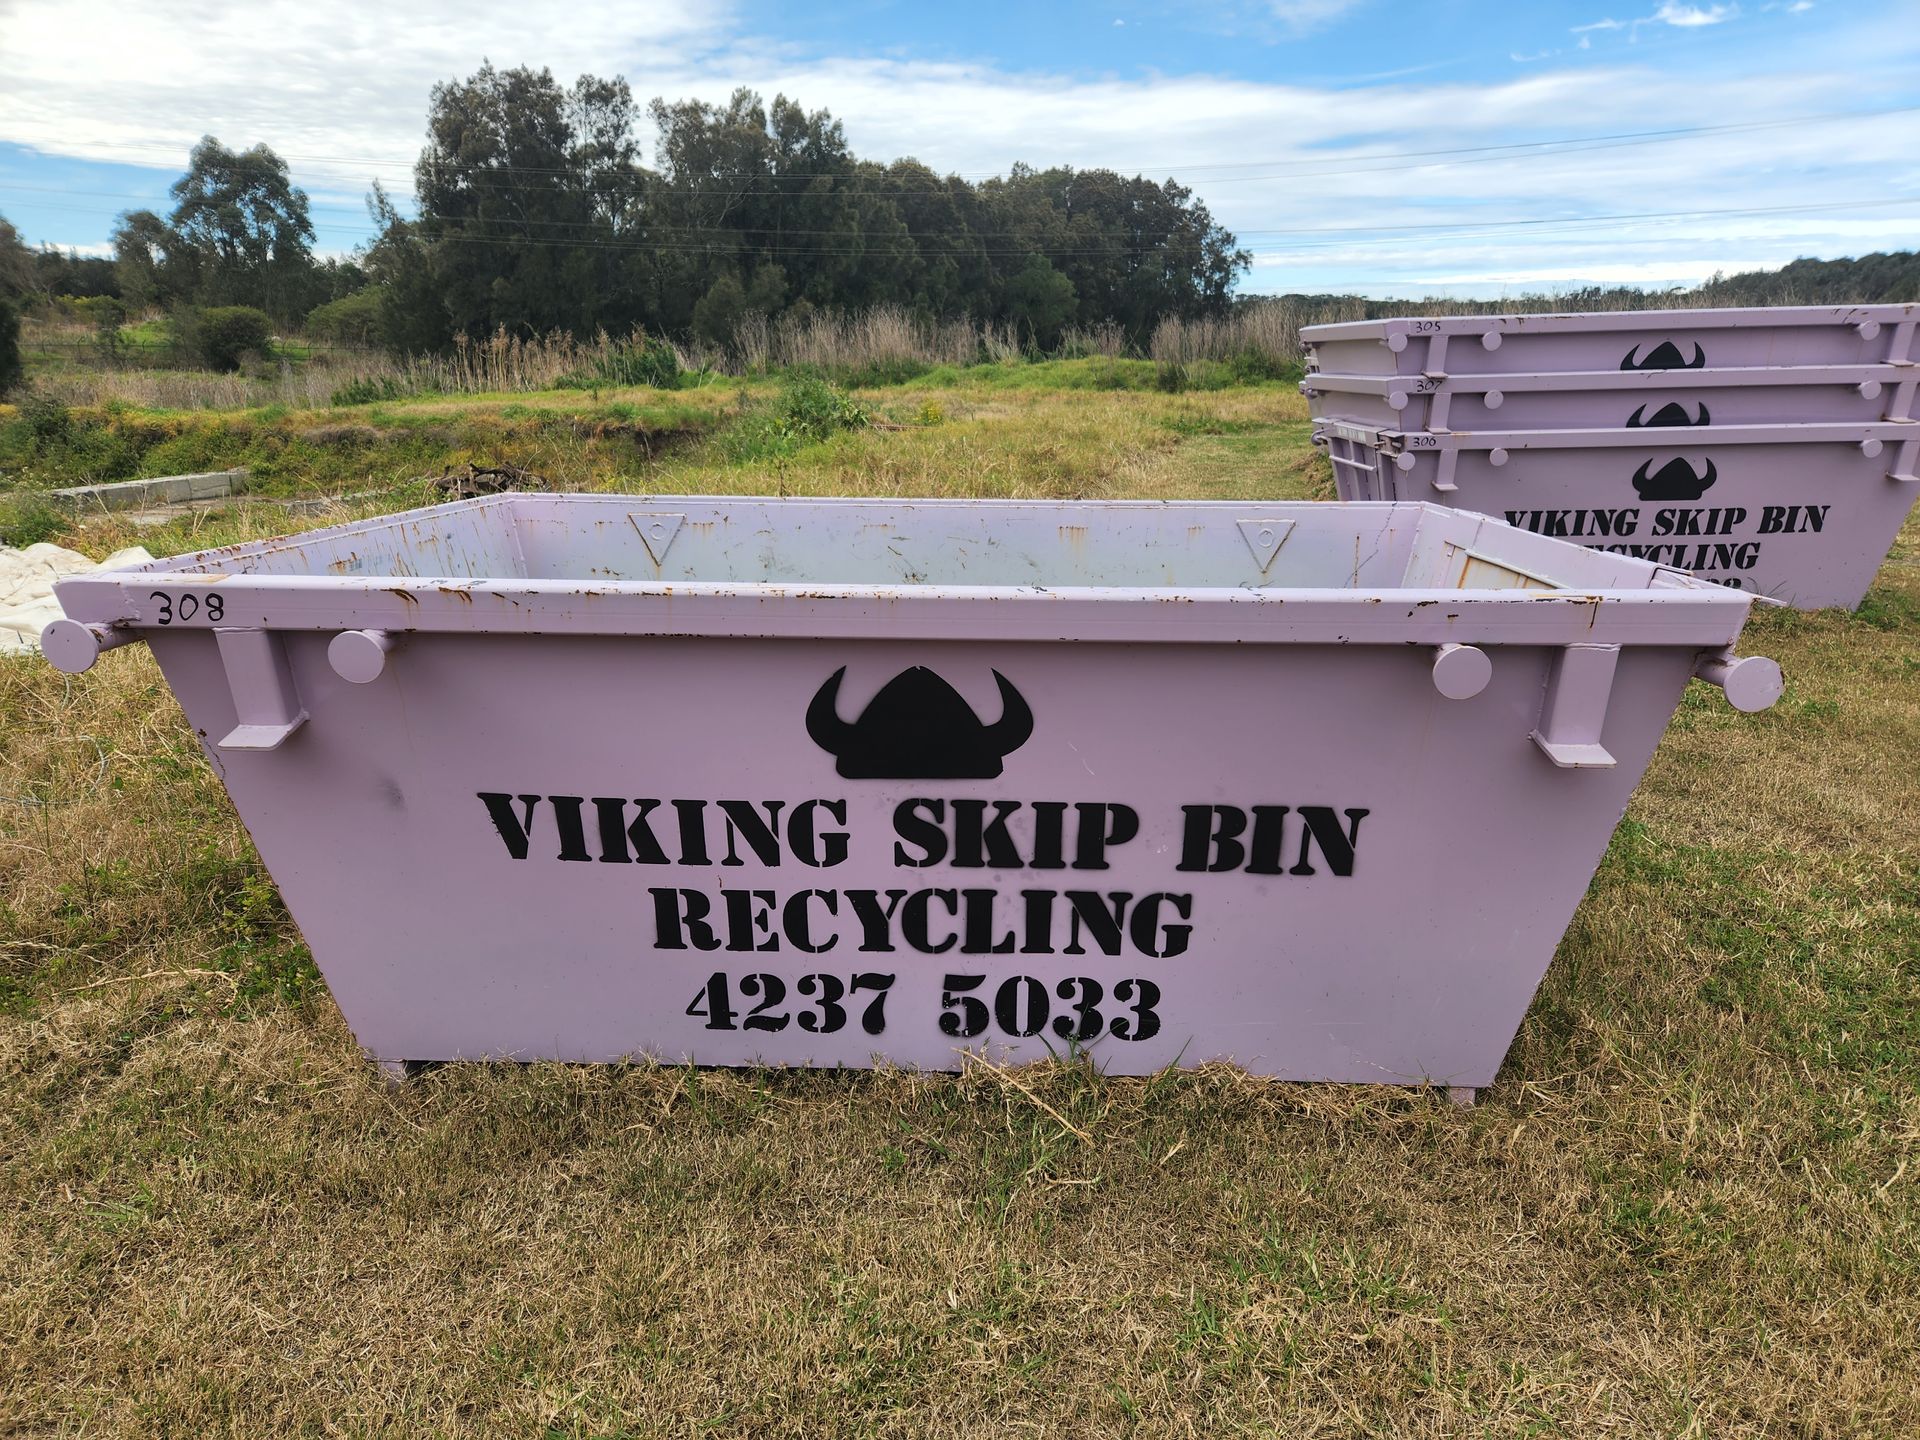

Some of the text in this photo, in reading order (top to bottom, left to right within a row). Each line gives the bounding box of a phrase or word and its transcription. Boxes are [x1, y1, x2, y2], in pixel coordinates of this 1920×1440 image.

[1415, 320, 1441, 333] 305
[1416, 380, 1443, 393] 307
[1412, 436, 1437, 447] 306
[1503, 504, 1832, 537] VIKING SKIP BIN
[149, 591, 224, 625] 308
[476, 791, 1371, 878] VIKING SKIP BIN
[647, 887, 1194, 959] RECYCLING
[685, 972, 1162, 1043] 4237 5033
